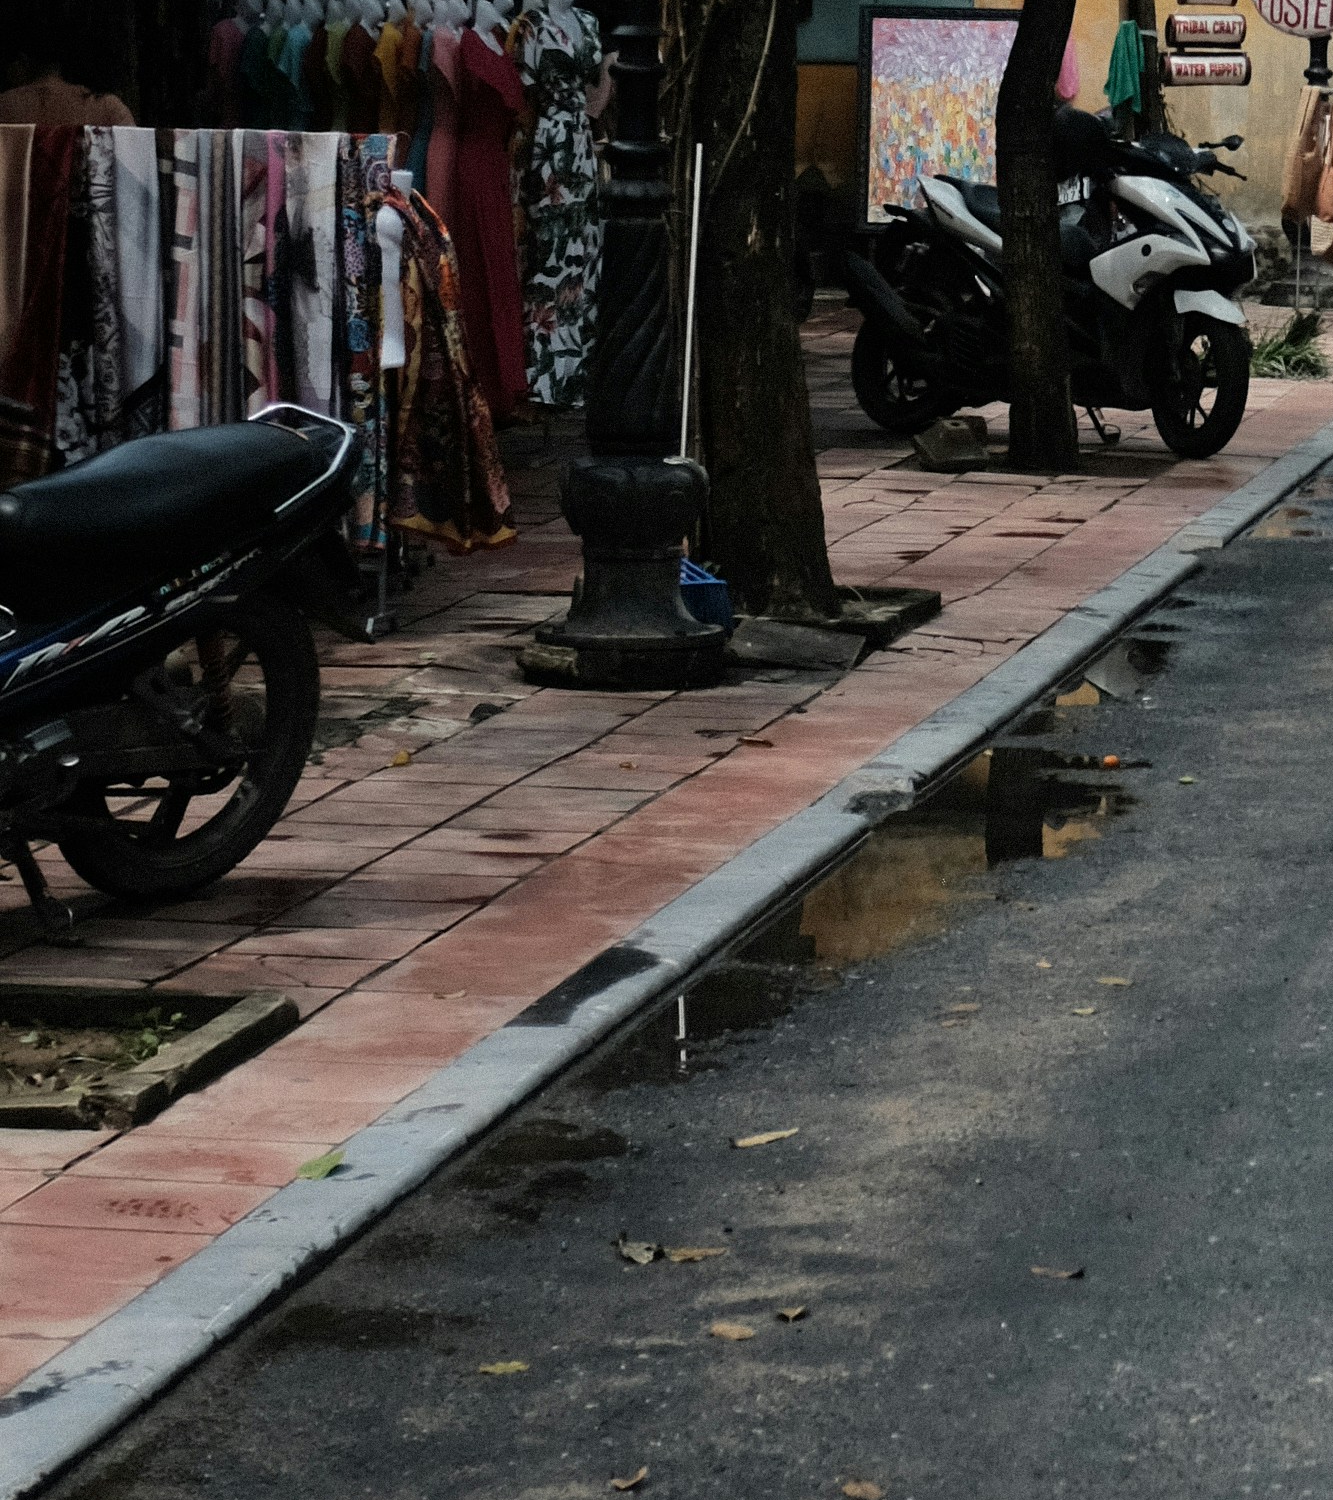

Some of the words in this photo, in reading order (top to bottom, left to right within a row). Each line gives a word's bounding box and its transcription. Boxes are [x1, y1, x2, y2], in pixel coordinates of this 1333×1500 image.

[1175, 20, 1209, 34] TRIBAL
[1213, 20, 1242, 35] CRAFT
[1175, 63, 1206, 77] WATER
[1209, 63, 1243, 77] PUPPET
